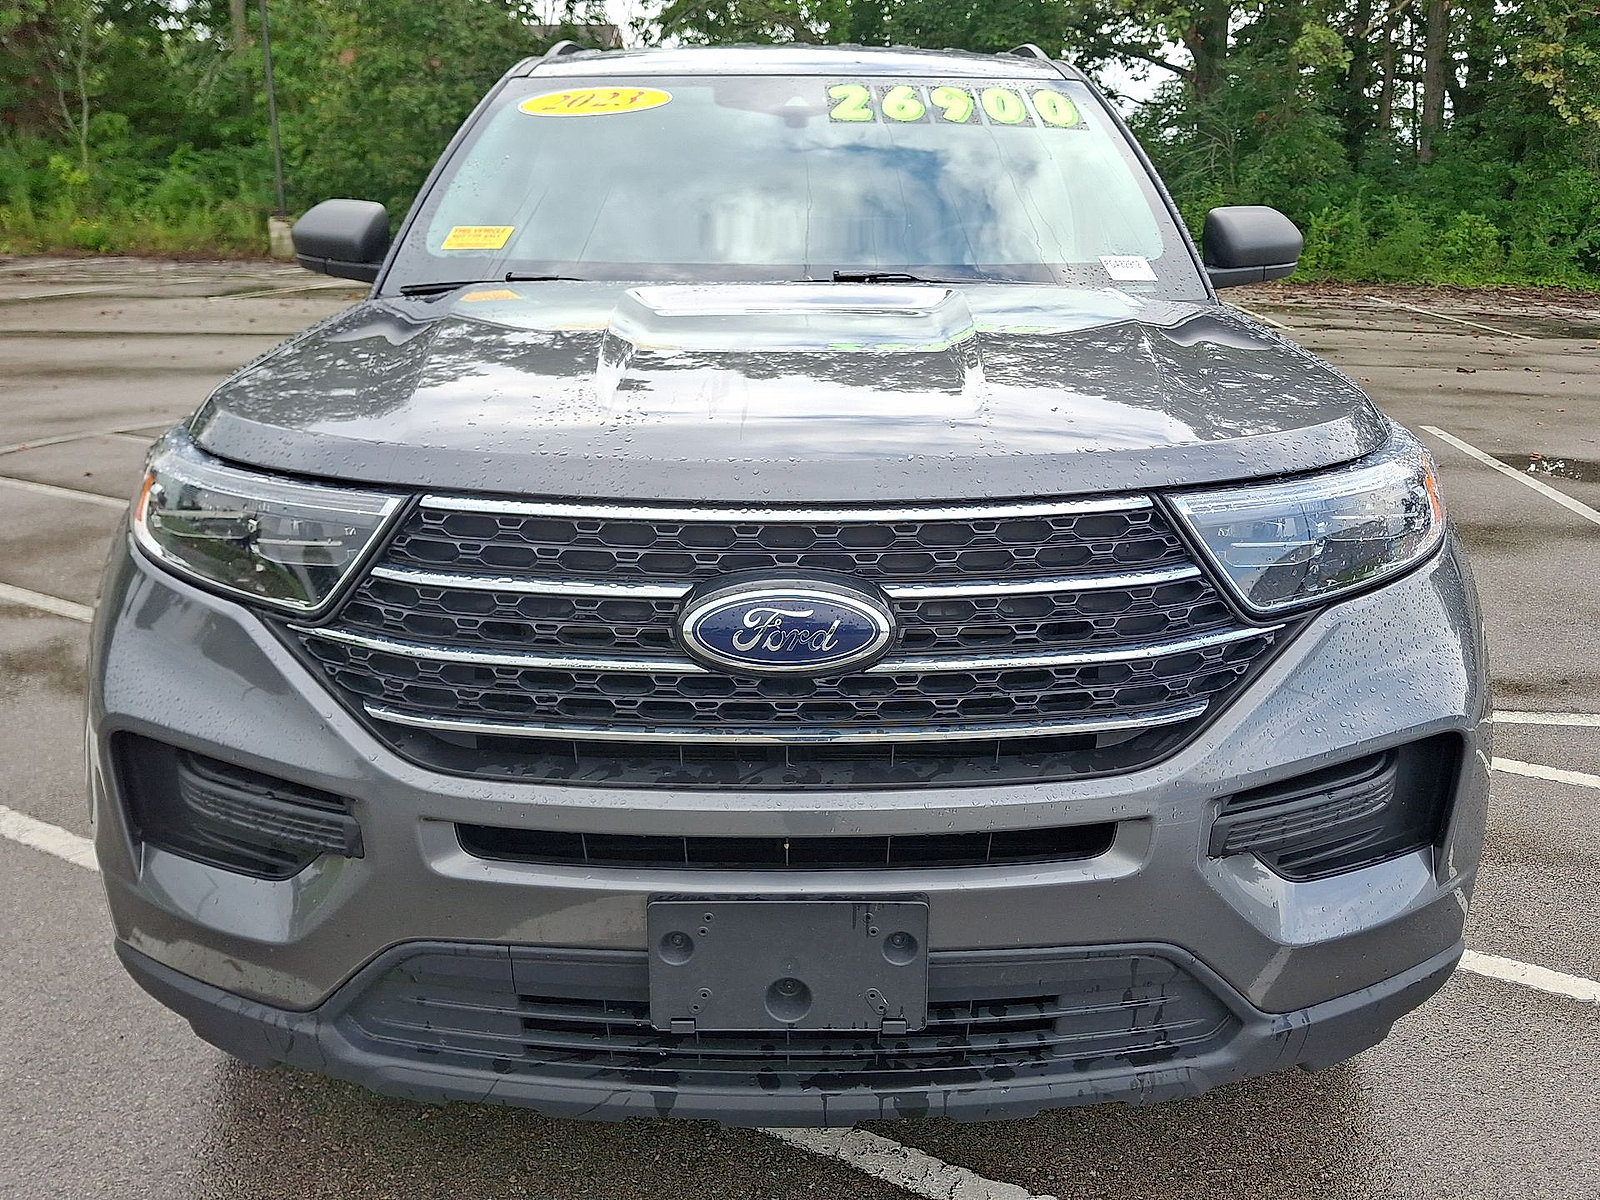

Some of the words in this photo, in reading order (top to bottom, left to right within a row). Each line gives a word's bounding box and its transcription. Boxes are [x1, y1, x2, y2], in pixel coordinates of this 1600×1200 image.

[541, 91, 646, 111] 2023
[826, 83, 1079, 128] 26900
[731, 606, 842, 652] Ford
